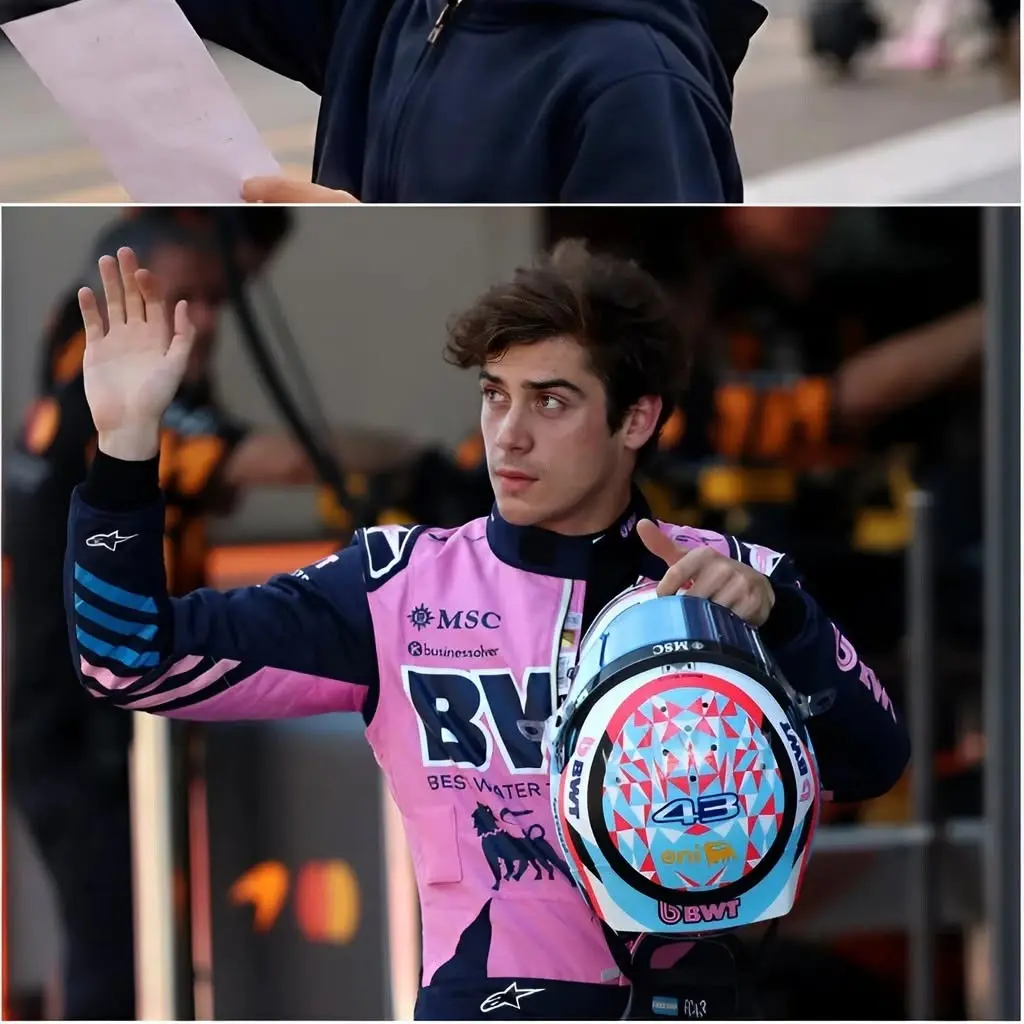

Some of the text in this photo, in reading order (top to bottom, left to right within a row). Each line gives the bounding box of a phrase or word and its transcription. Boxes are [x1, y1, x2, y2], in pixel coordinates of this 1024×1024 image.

[436, 609, 501, 629] MSC
[652, 640, 689, 655] MSC
[780, 722, 808, 776] BWT
[473, 776, 542, 800] WATER
[569, 760, 584, 819] BWT
[652, 792, 740, 825] 43
[683, 897, 741, 924] BWT
